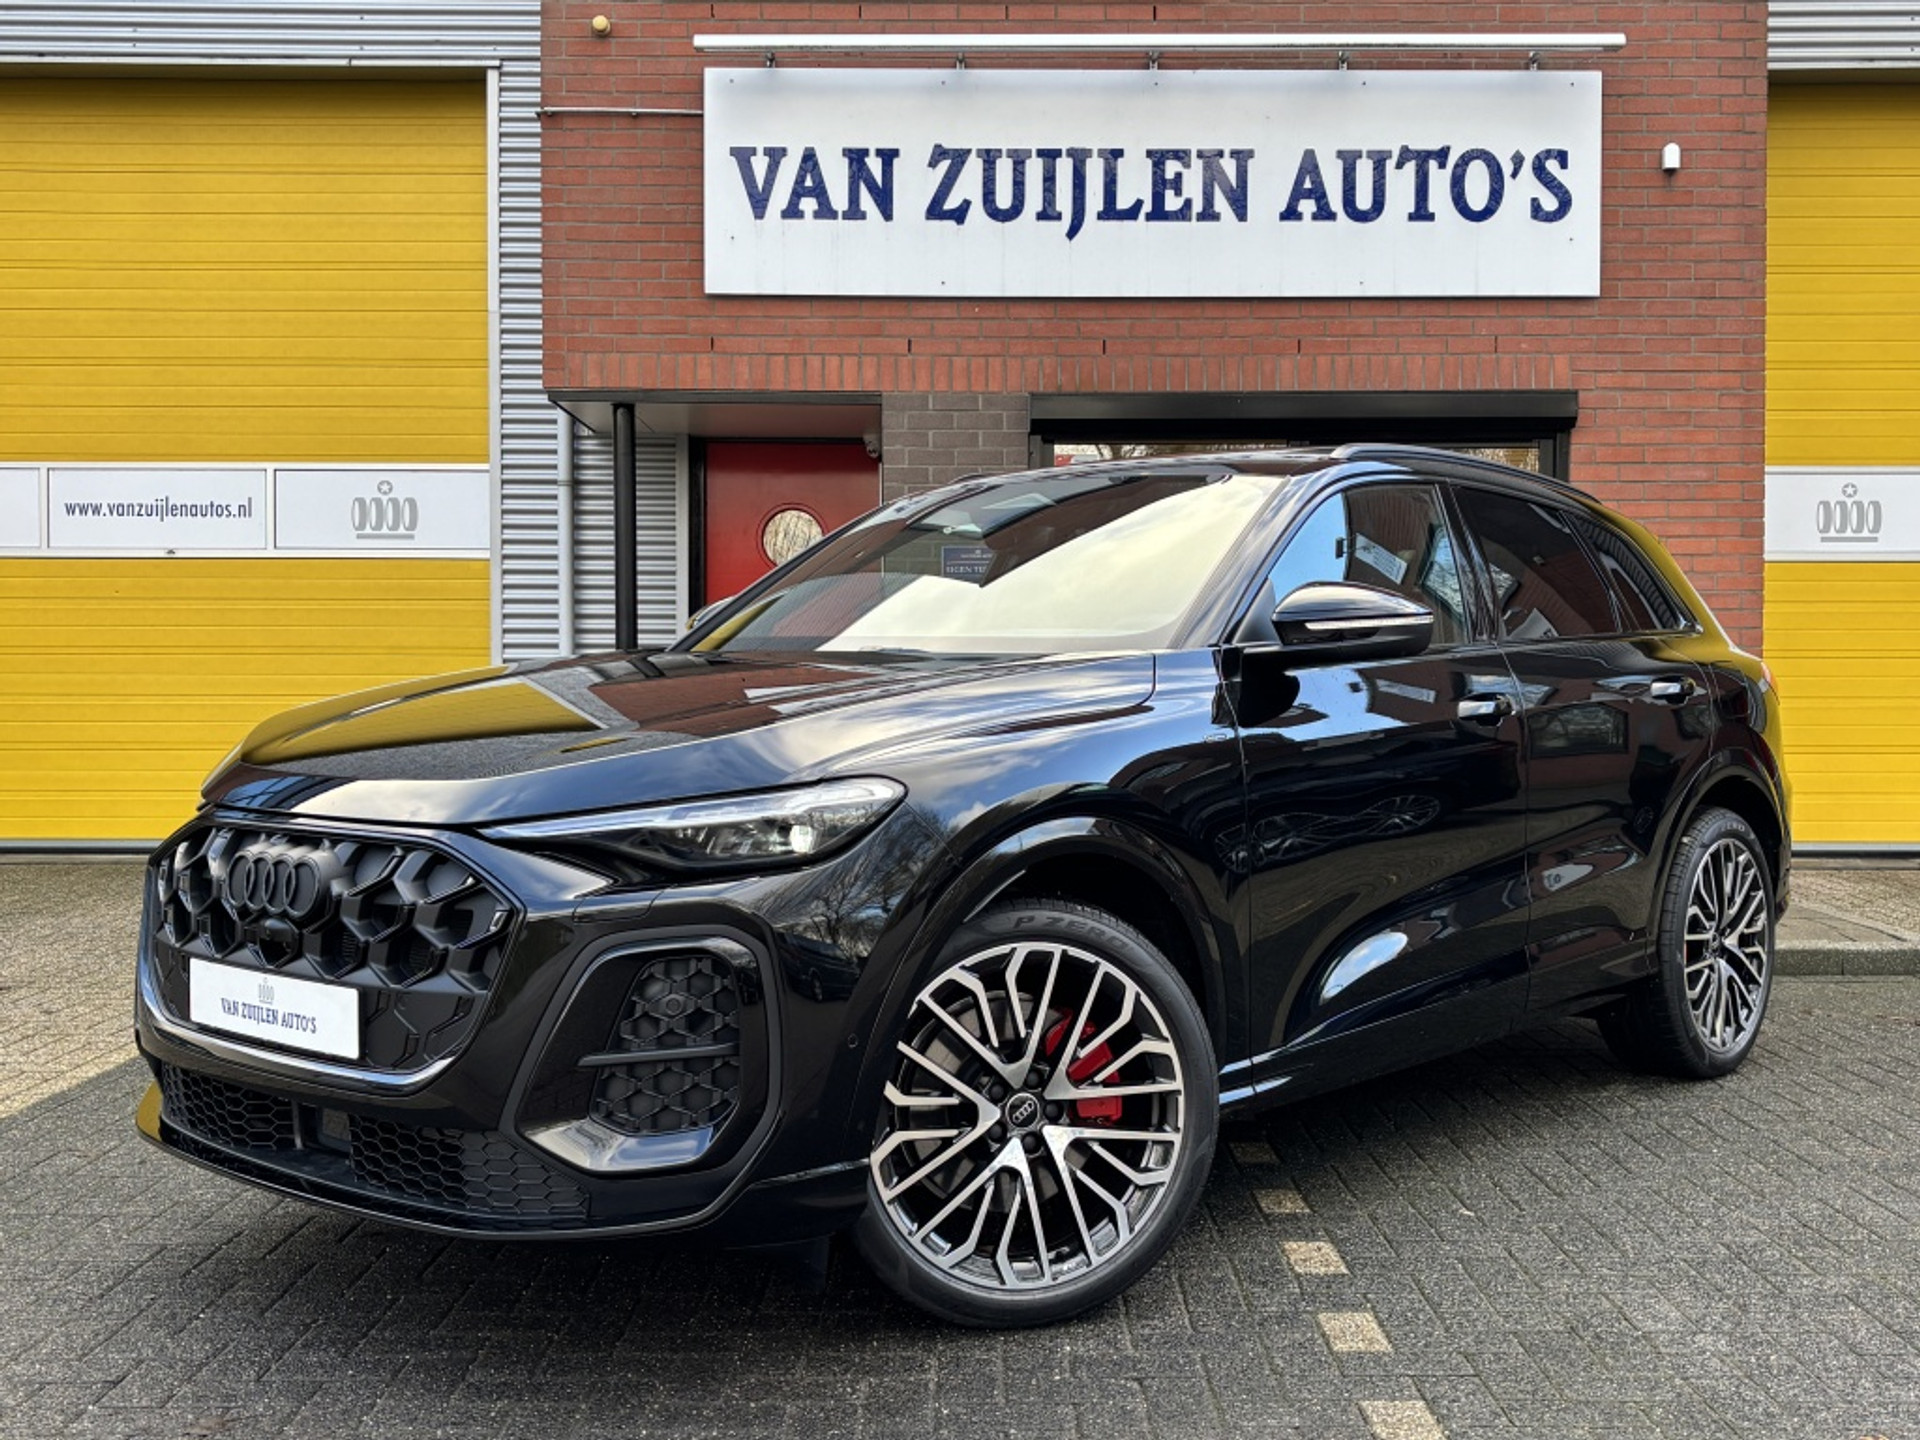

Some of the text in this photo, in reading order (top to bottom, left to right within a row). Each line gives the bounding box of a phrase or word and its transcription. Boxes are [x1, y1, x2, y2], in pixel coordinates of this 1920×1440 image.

[729, 144, 1573, 241] VAN ZUIJLEN AUTO'S
[64, 496, 252, 522] www.vanzuijlenautos.nl
[221, 997, 317, 1034] VAN ZUIJLEN AUTO'S
